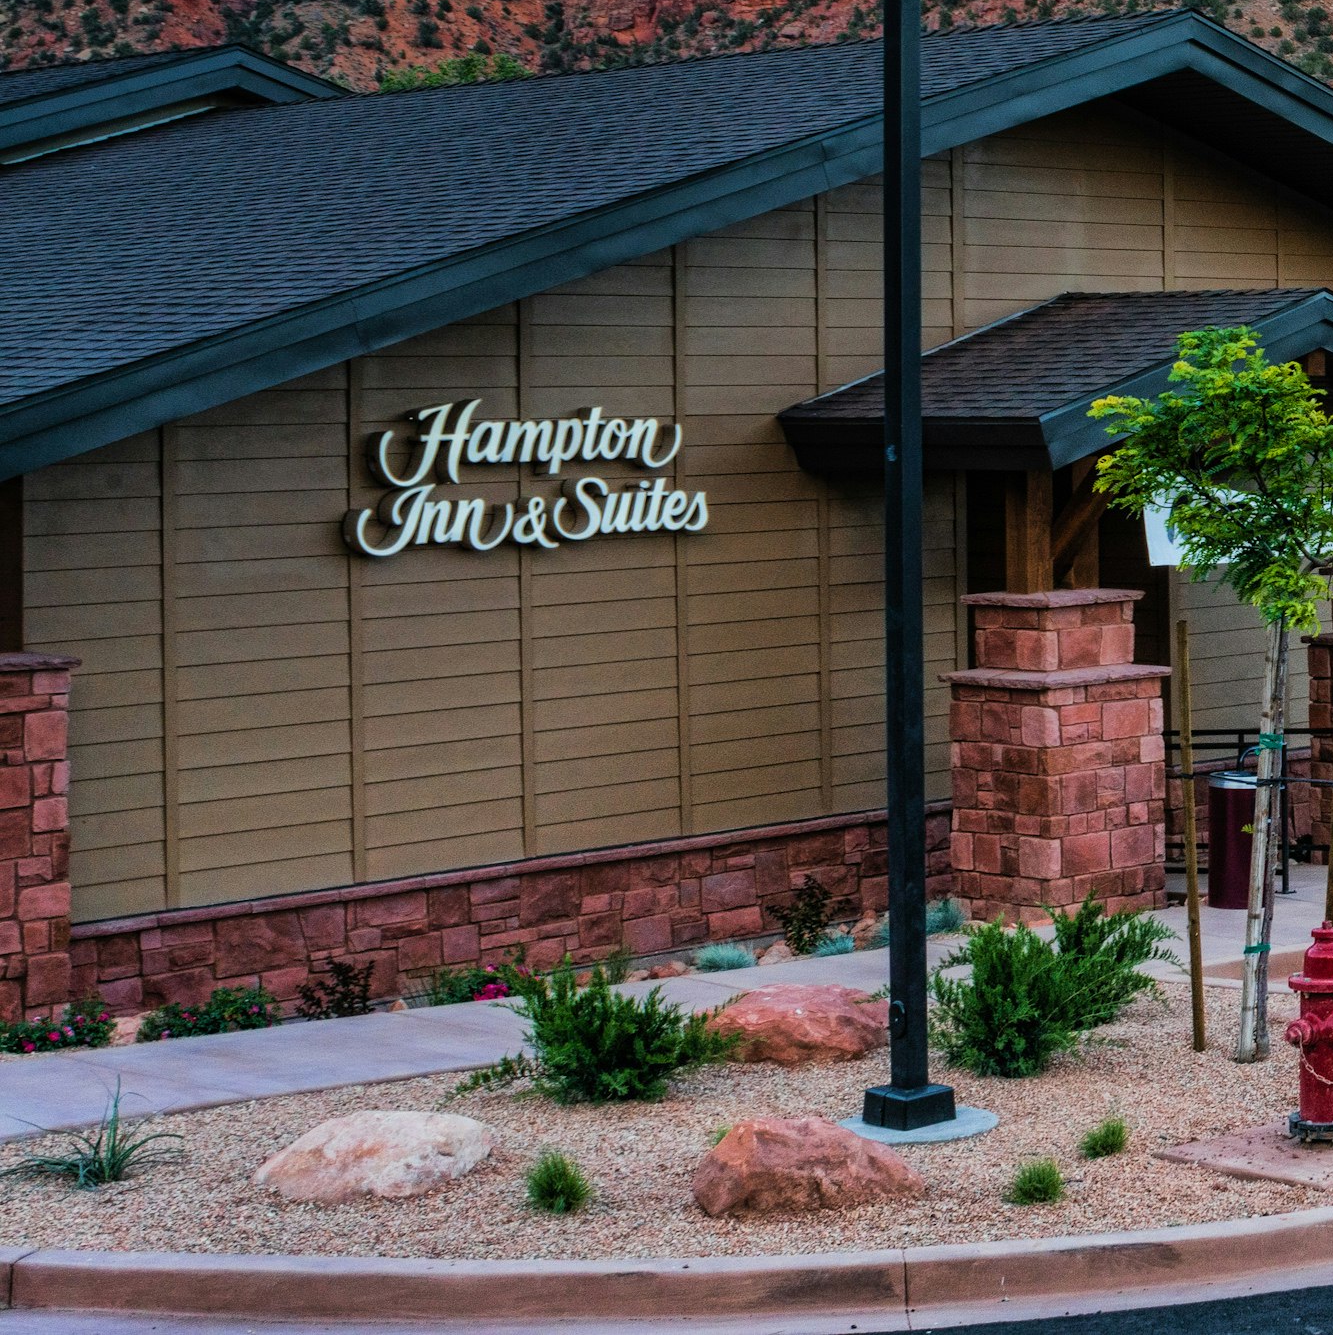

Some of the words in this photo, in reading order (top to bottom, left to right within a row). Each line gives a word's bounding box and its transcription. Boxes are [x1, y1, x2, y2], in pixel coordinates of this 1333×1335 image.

[379, 398, 682, 487] Hampton
[356, 483, 513, 558] Inn
[511, 496, 561, 549] &
[552, 476, 710, 541] Suites
